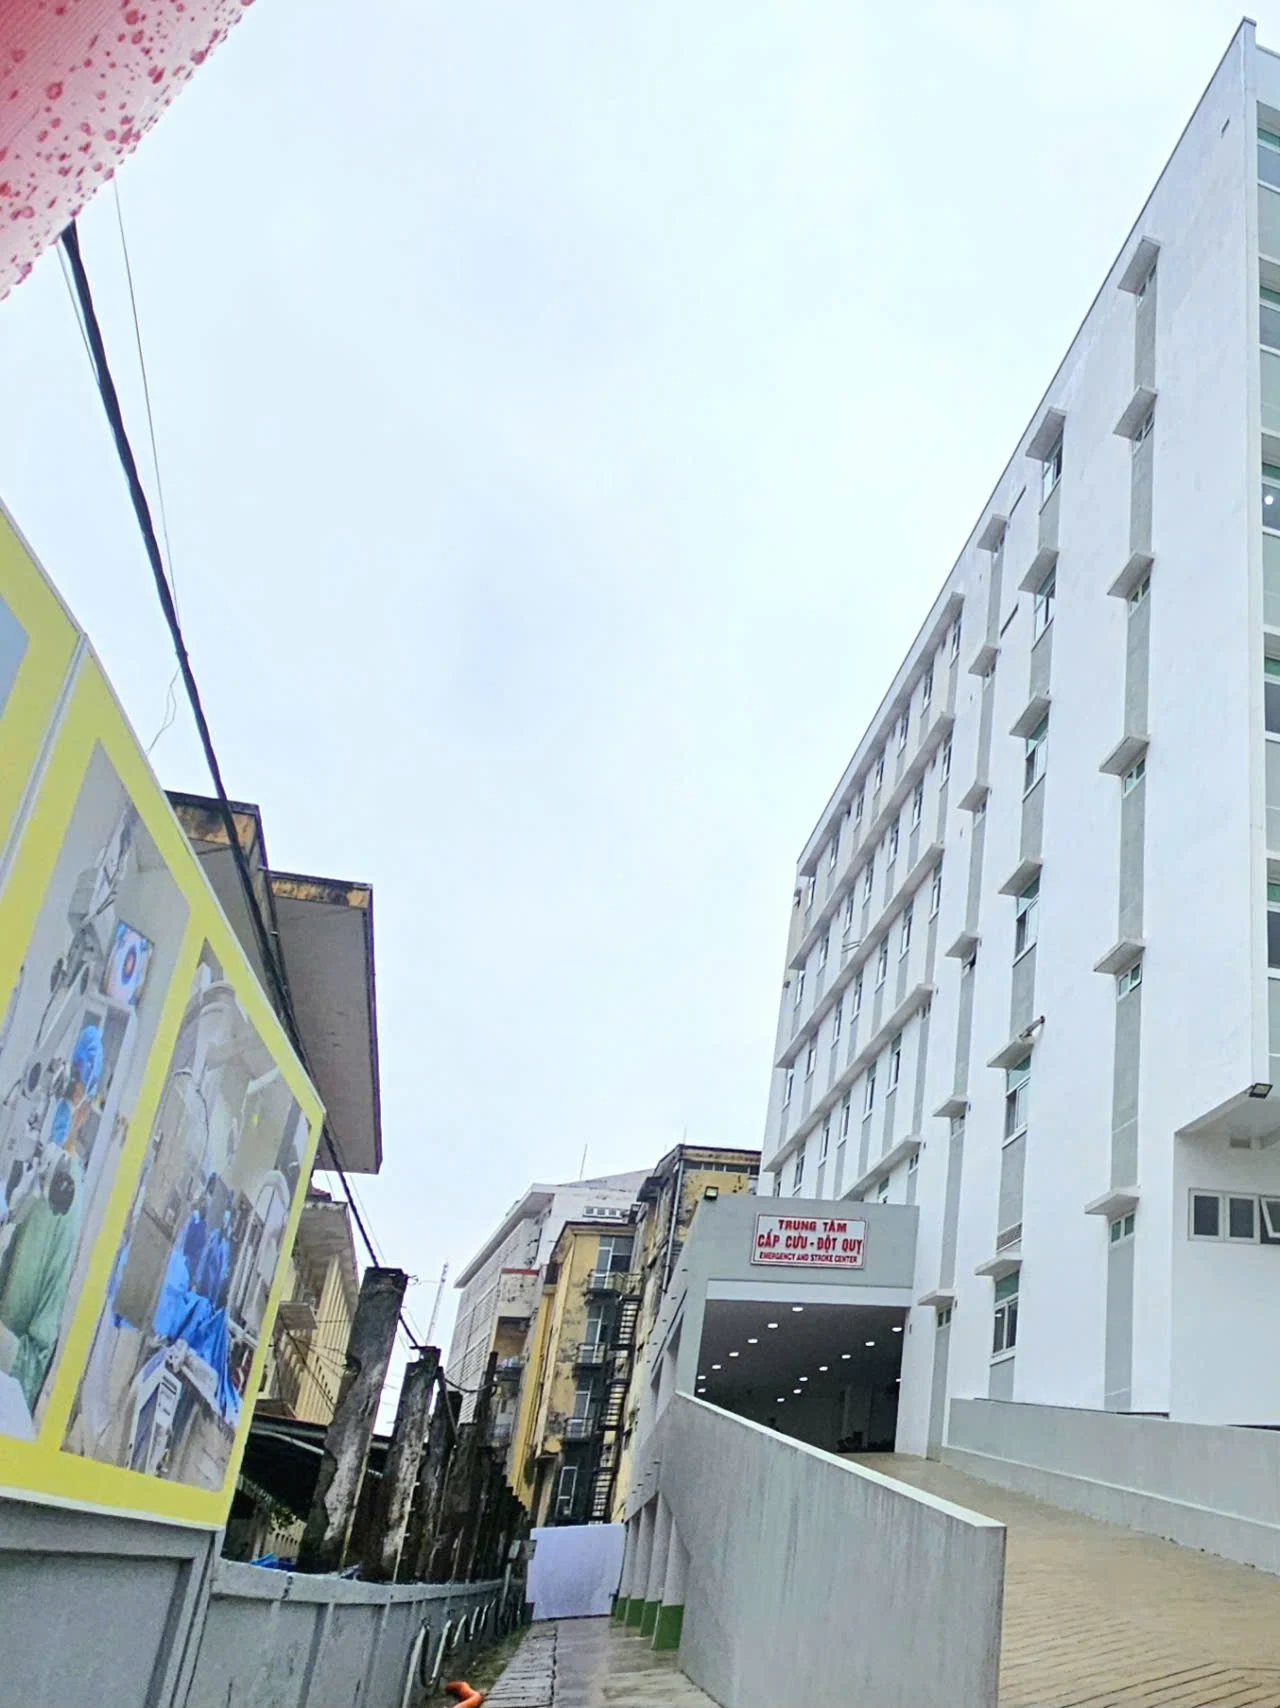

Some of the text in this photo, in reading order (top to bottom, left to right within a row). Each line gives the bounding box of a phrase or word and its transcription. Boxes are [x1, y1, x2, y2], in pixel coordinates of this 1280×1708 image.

[778, 1219, 848, 1233] TRUNG TÂM
[757, 1228, 780, 1249] CẤP
[785, 1232, 809, 1250] CỨU
[817, 1234, 838, 1253] ĐỘT
[796, 1252, 809, 1261] AND
